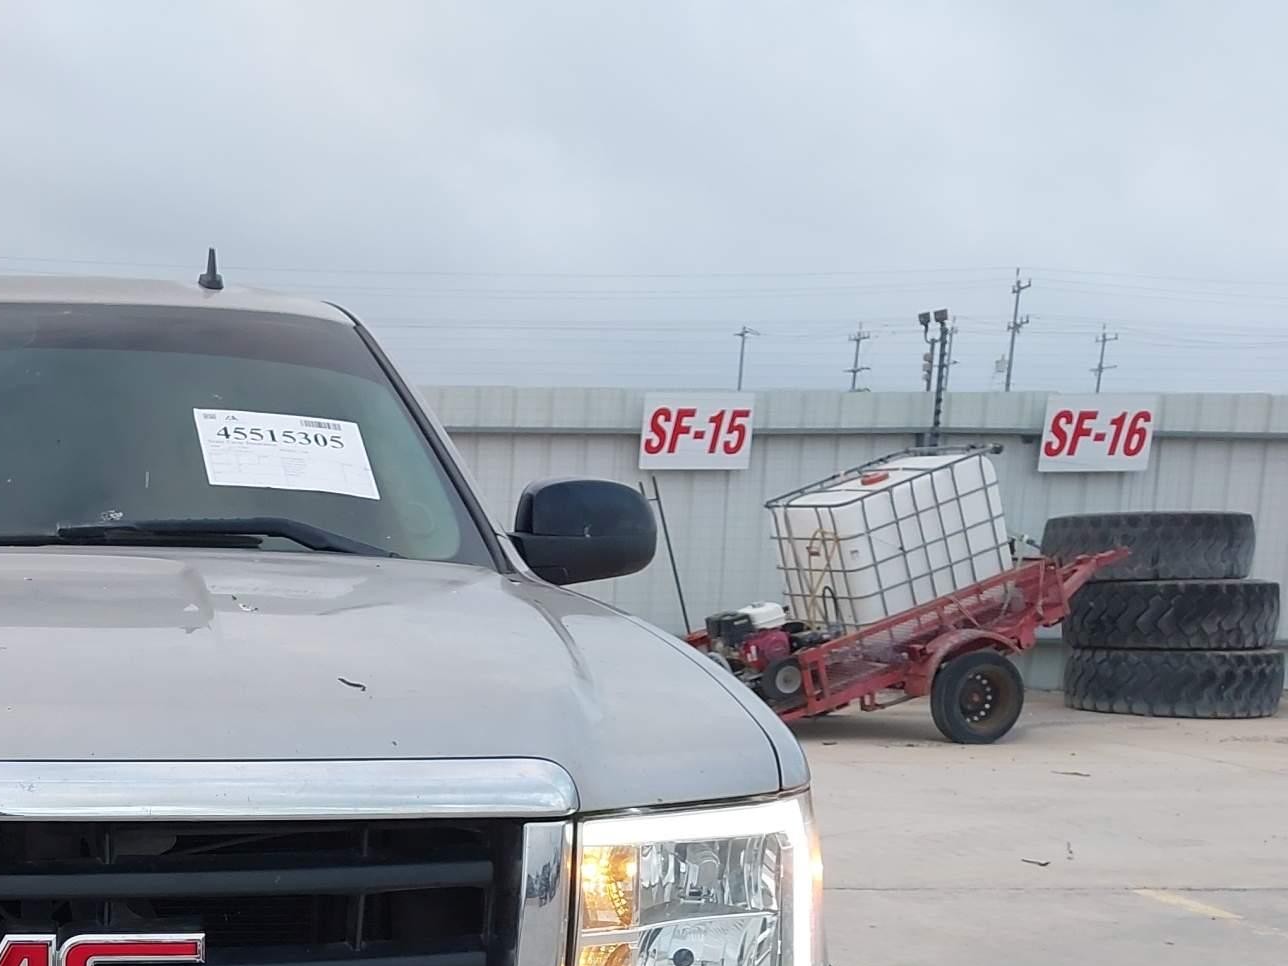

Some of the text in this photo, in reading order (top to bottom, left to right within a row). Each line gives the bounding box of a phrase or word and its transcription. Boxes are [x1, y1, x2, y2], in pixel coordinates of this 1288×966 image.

[216, 426, 344, 449] 45515305
[644, 407, 751, 454] SF-15
[1044, 410, 1152, 456] SF-16
